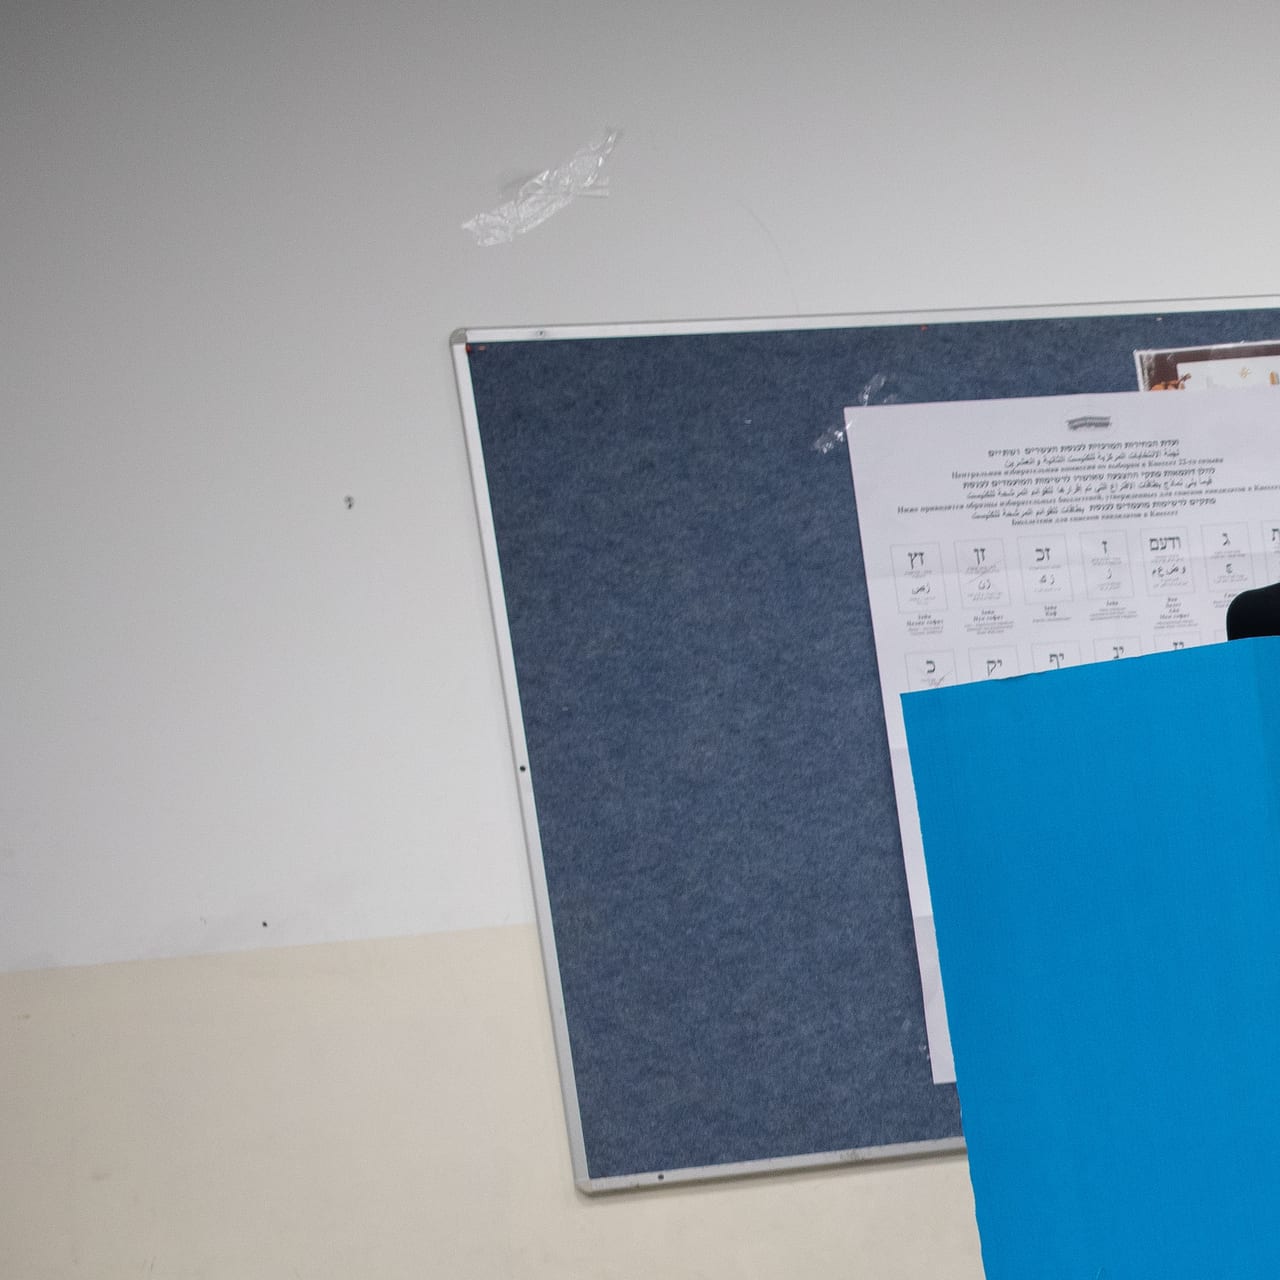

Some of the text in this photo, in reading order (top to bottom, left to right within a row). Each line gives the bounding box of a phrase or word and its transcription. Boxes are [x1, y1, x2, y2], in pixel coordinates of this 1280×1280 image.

[1150, 537, 1181, 551] ודעם
[1222, 533, 1231, 546] ג
[1101, 540, 1108, 554] ז
[907, 552, 925, 569] זץ
[1035, 548, 1051, 561] זכ
[926, 660, 936, 674] כ
[986, 659, 1002, 676] יק
